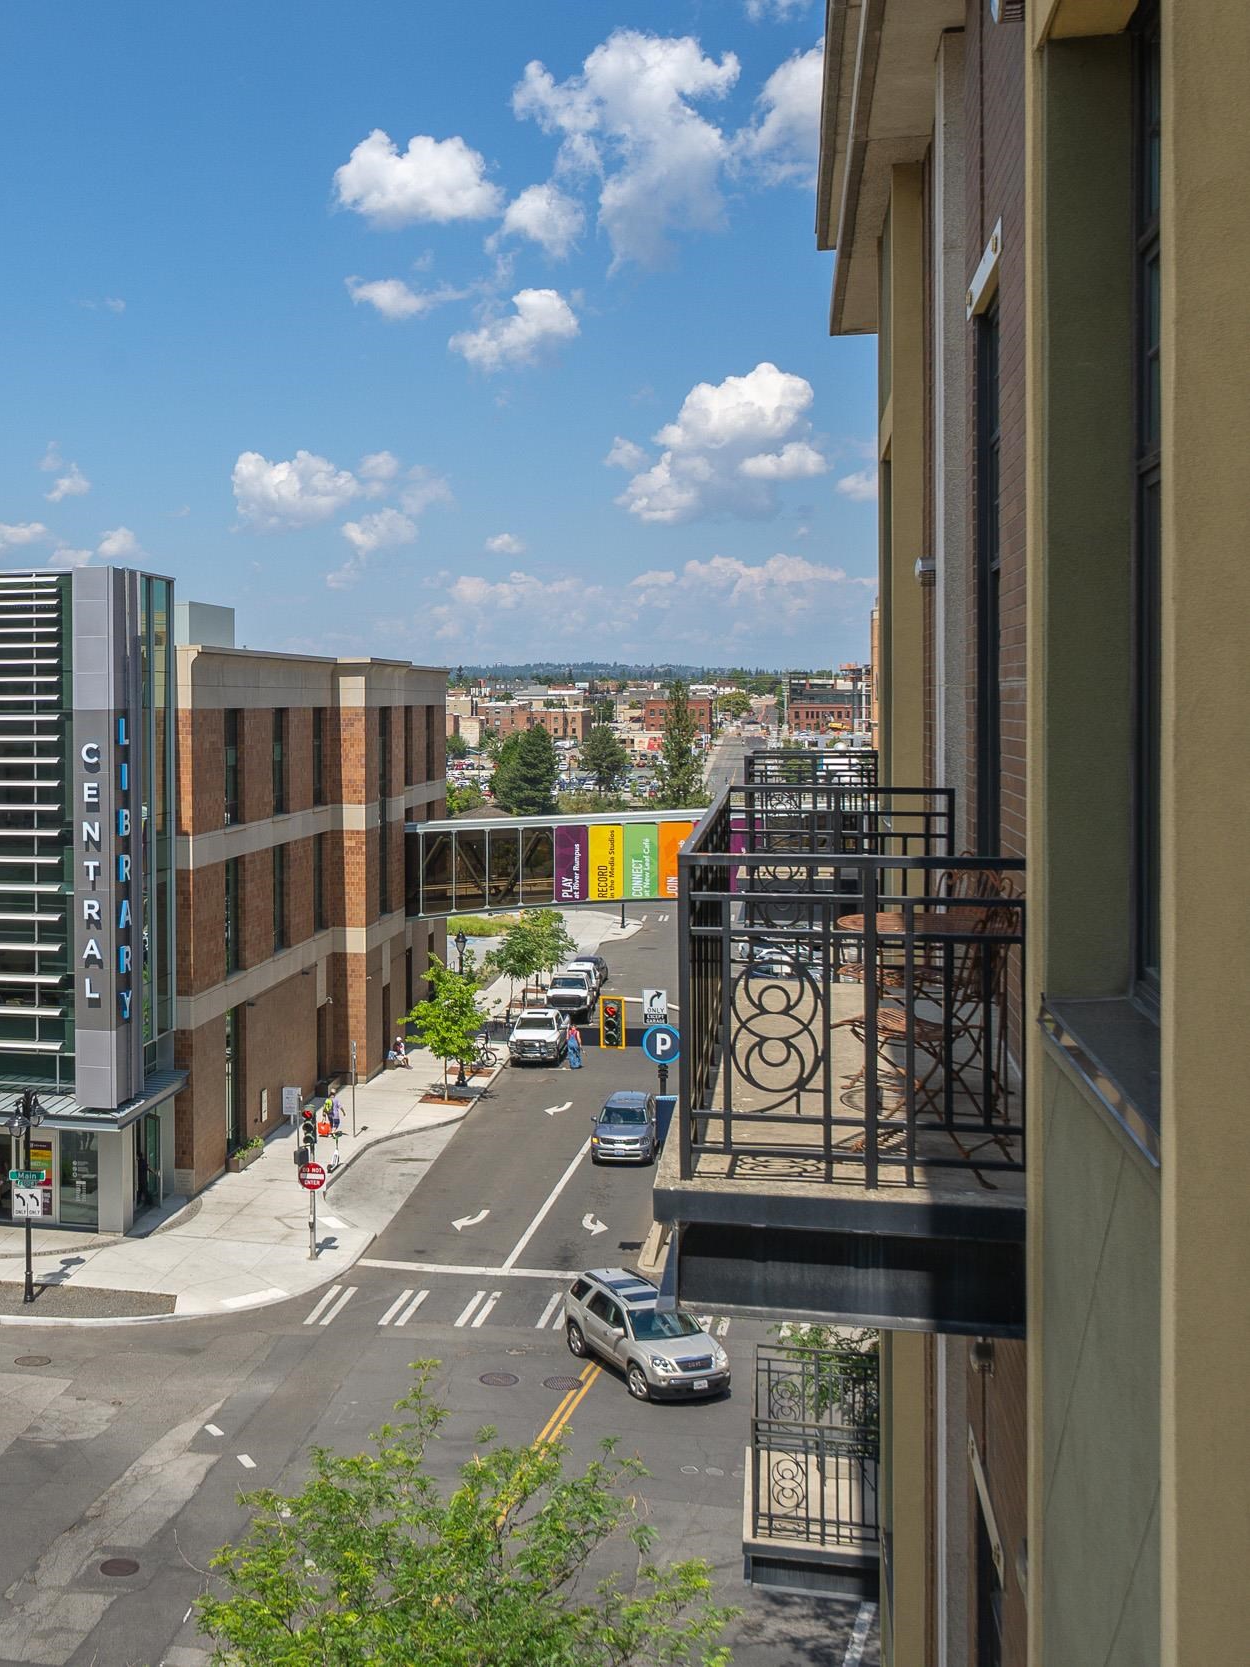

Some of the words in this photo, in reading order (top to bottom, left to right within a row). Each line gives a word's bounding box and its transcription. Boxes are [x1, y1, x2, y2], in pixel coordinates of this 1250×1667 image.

[118, 718, 132, 1019] LIBRARY
[573, 844, 581, 871] Rumpus
[81, 743, 102, 998] CENTRAL
[598, 865, 608, 898] RECORD
[632, 858, 643, 897] CONNECT
[562, 877, 573, 898] PLAY
[574, 891, 580, 899] at
[644, 889, 650, 897] at
[667, 876, 679, 897] JOIN
[656, 1033, 671, 1055] P
[17, 1172, 37, 1180] Main
